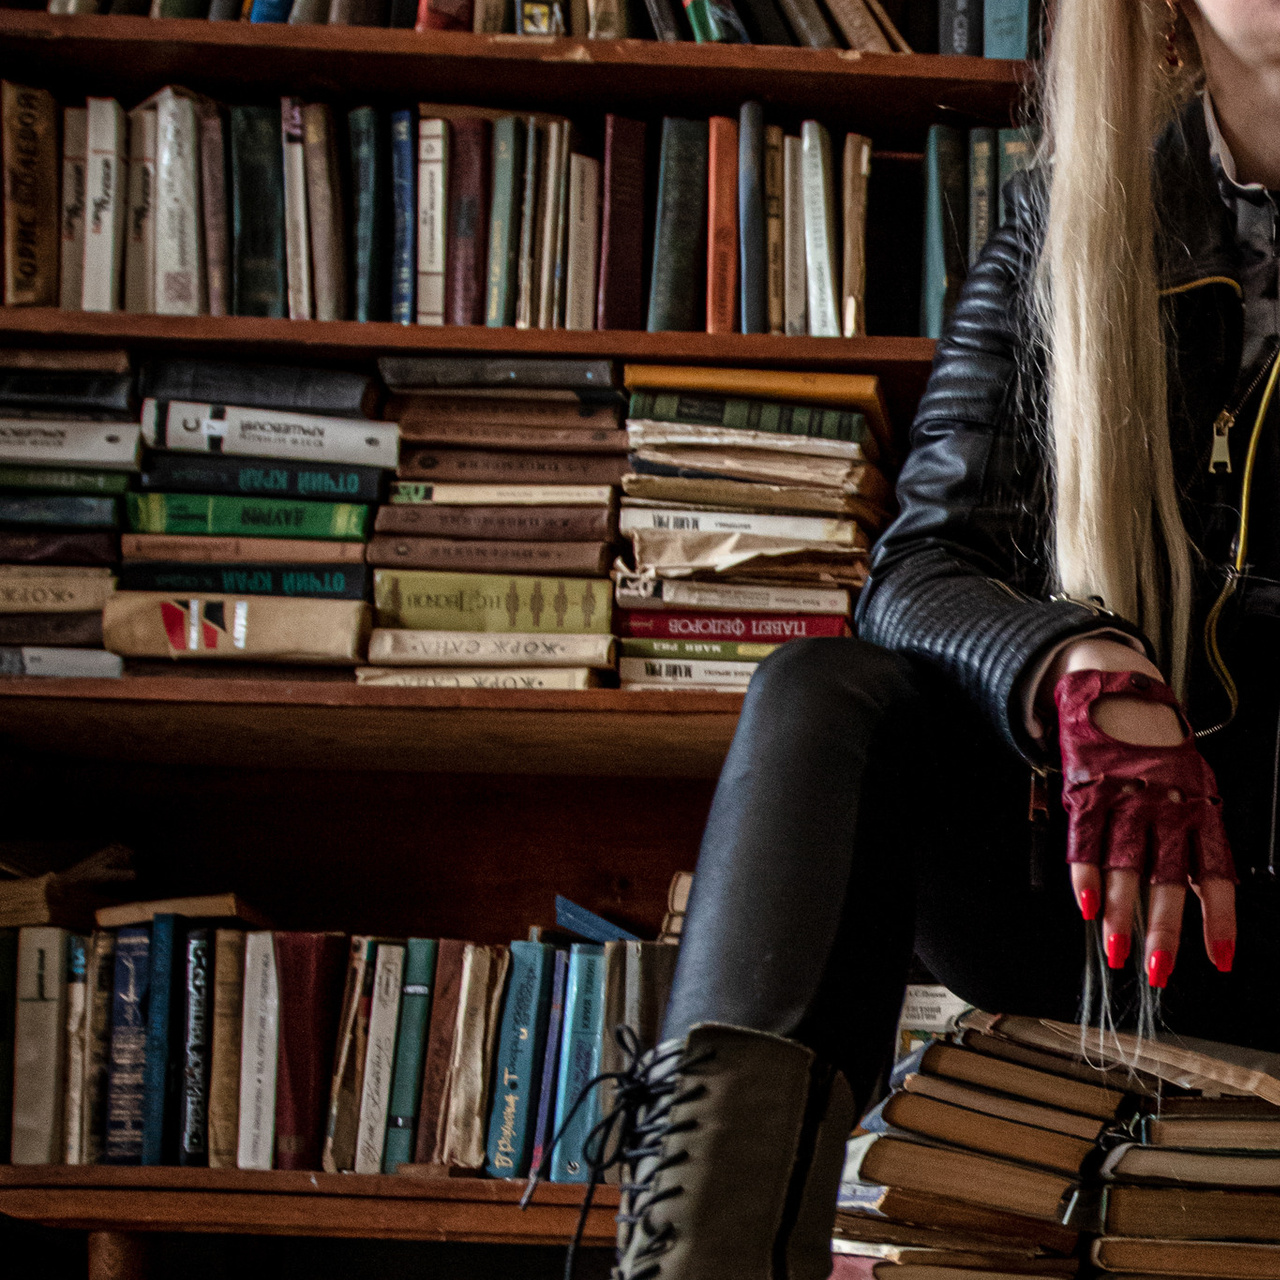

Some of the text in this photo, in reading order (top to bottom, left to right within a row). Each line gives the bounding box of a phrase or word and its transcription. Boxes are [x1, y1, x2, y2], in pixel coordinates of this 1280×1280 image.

[238, 467, 287, 490] КРАЙ
[298, 470, 359, 494] ОТЧИЙ
[222, 572, 272, 592] КРАЙ
[282, 573, 346, 593] ОТЧИЙ
[667, 617, 807, 636] ПАВЕЛ ФЕДОРОВ
[419, 639, 559, 654] ЖОРЖ САНД
[684, 642, 722, 653] МАЙН
